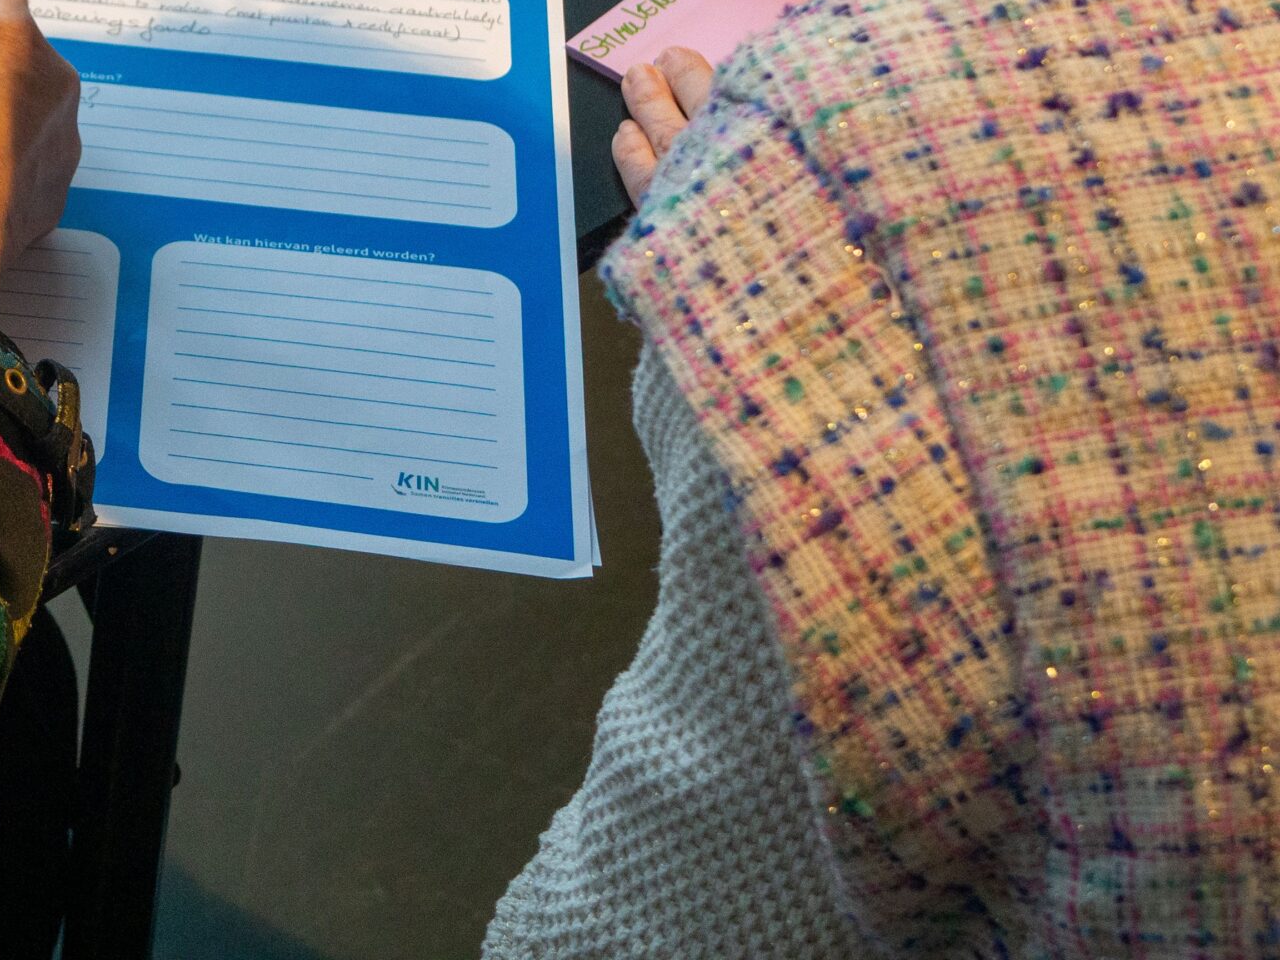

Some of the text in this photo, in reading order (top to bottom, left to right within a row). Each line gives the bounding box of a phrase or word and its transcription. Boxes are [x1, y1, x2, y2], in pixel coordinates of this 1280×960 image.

[193, 233, 436, 262] Wat kan hiervan geleerd worden?
[397, 472, 439, 492] KIN
